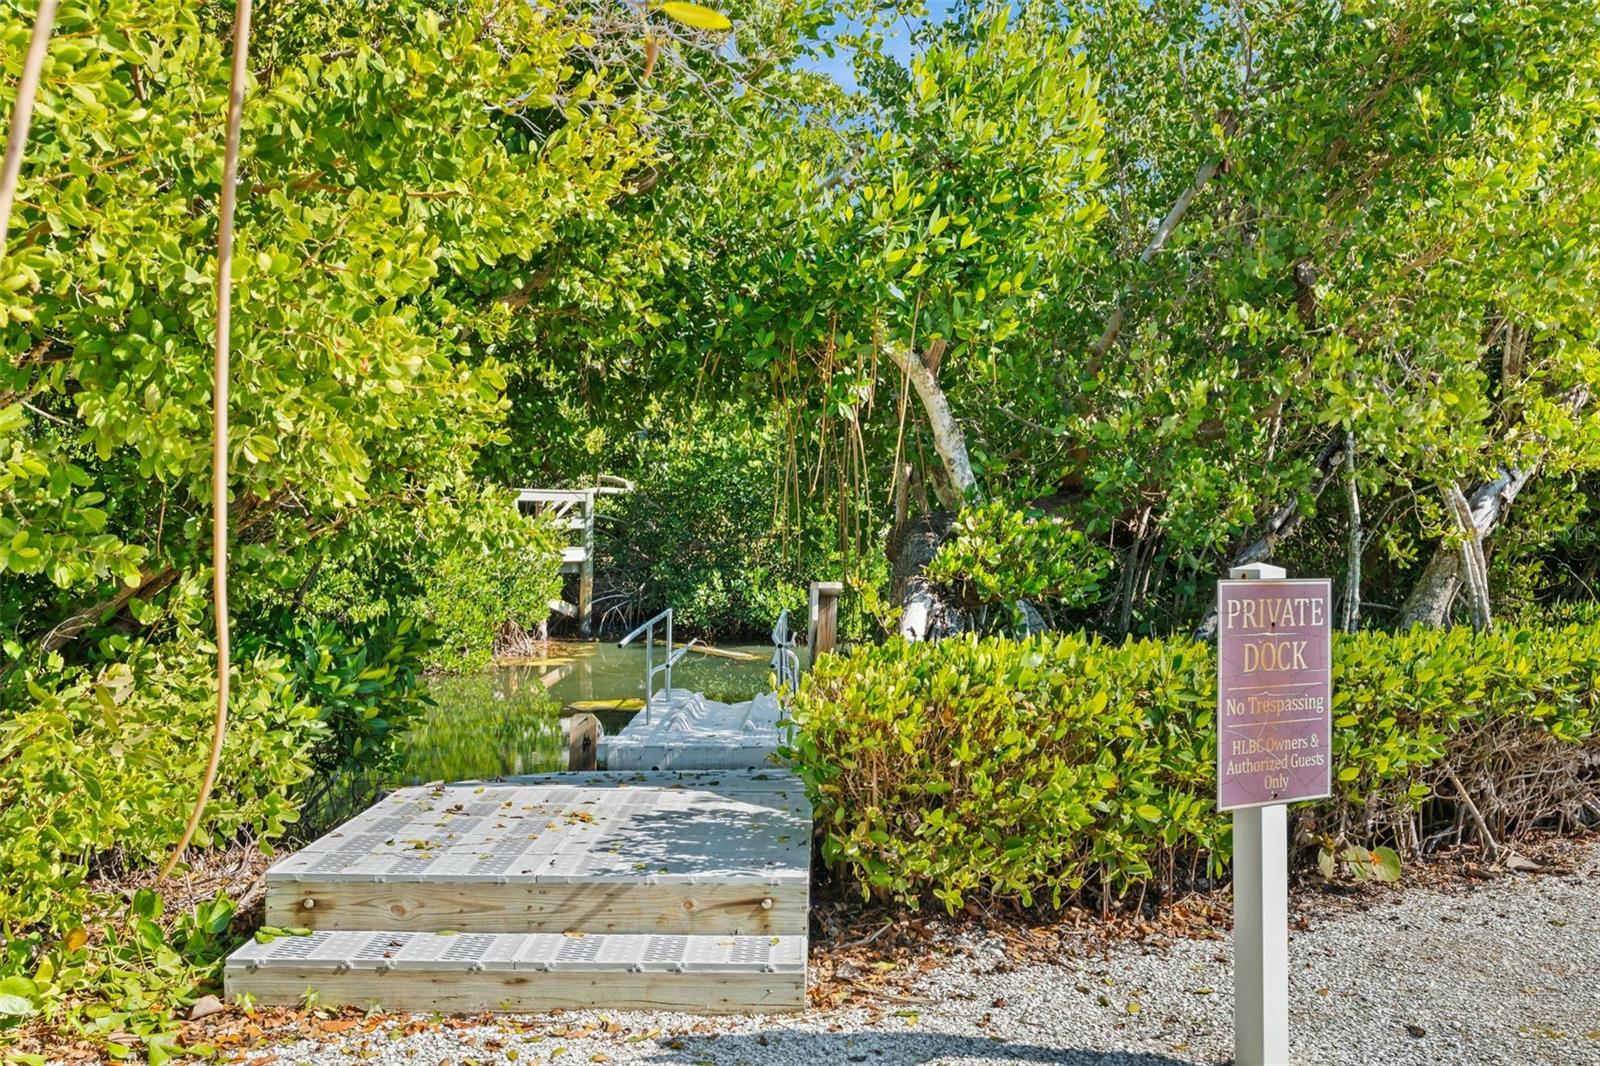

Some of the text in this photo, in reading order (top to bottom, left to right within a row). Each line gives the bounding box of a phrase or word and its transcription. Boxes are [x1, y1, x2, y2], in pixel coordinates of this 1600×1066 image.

[1226, 598, 1324, 629] PRIVATE
[1243, 641, 1308, 673] DOCK
[1226, 694, 1324, 716] No Trespassing
[1232, 733, 1319, 756] HLBC Owners &
[1226, 753, 1325, 775] Authorized Guests
[1264, 773, 1289, 791] Only
